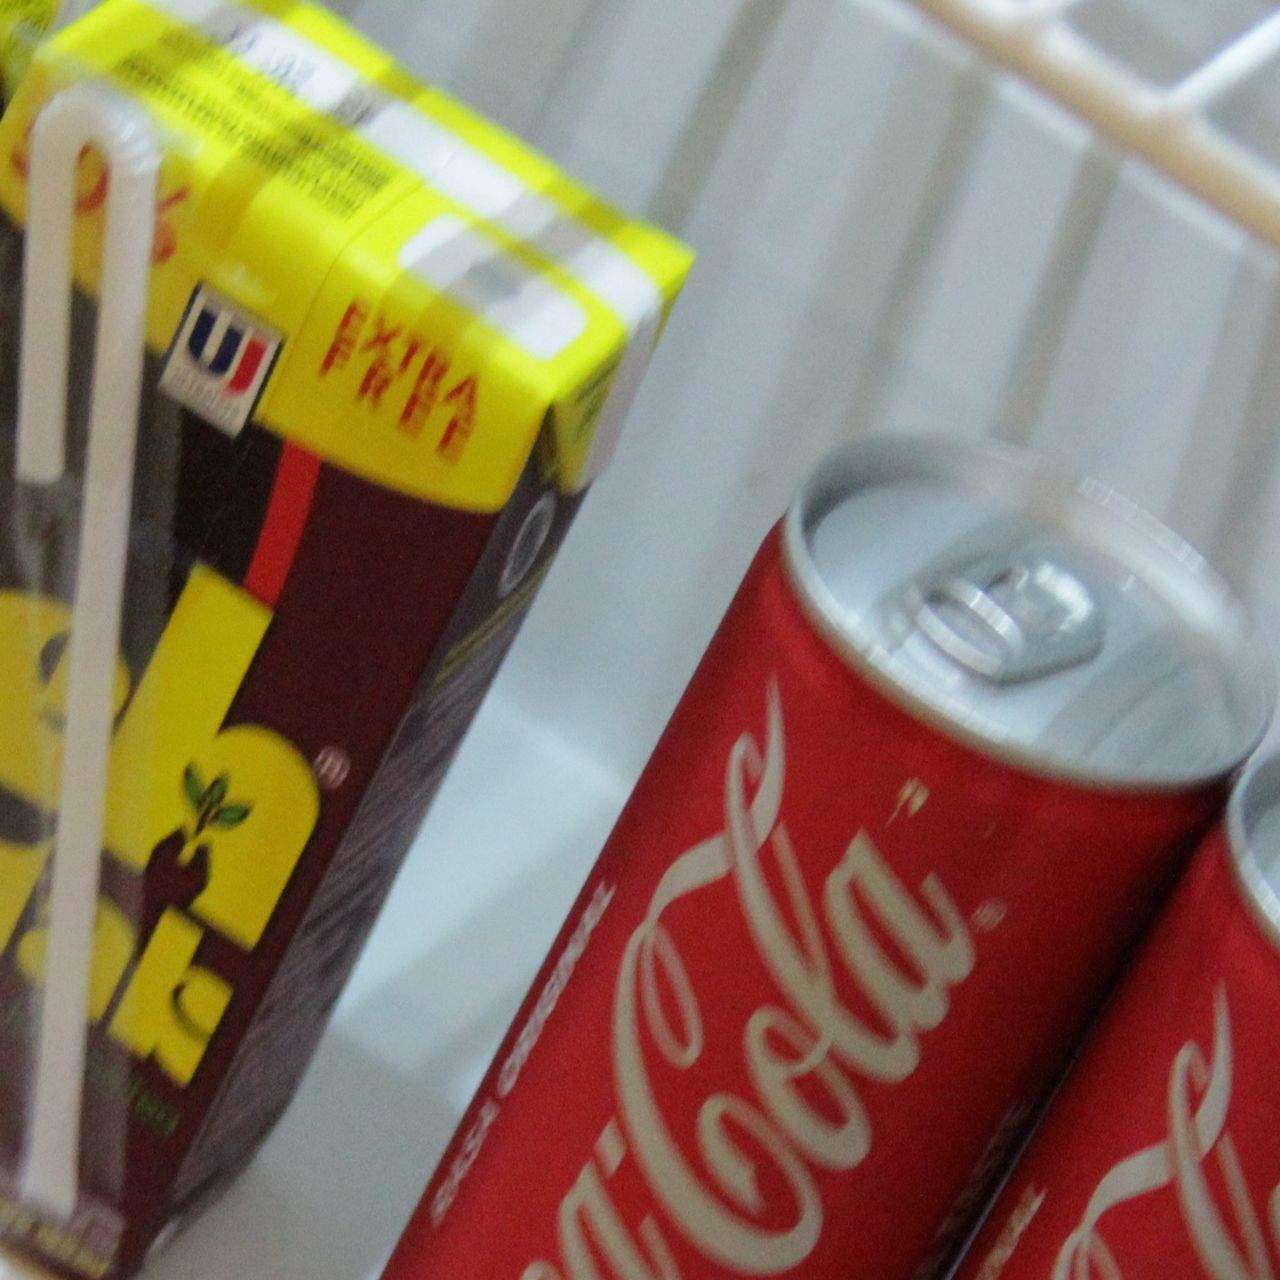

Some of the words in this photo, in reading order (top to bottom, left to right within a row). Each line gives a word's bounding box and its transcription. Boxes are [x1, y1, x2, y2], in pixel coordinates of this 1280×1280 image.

[321, 338, 468, 464] FREE
[332, 299, 479, 424] EXTRA
[497, 879, 617, 1099] ORIGINAL
